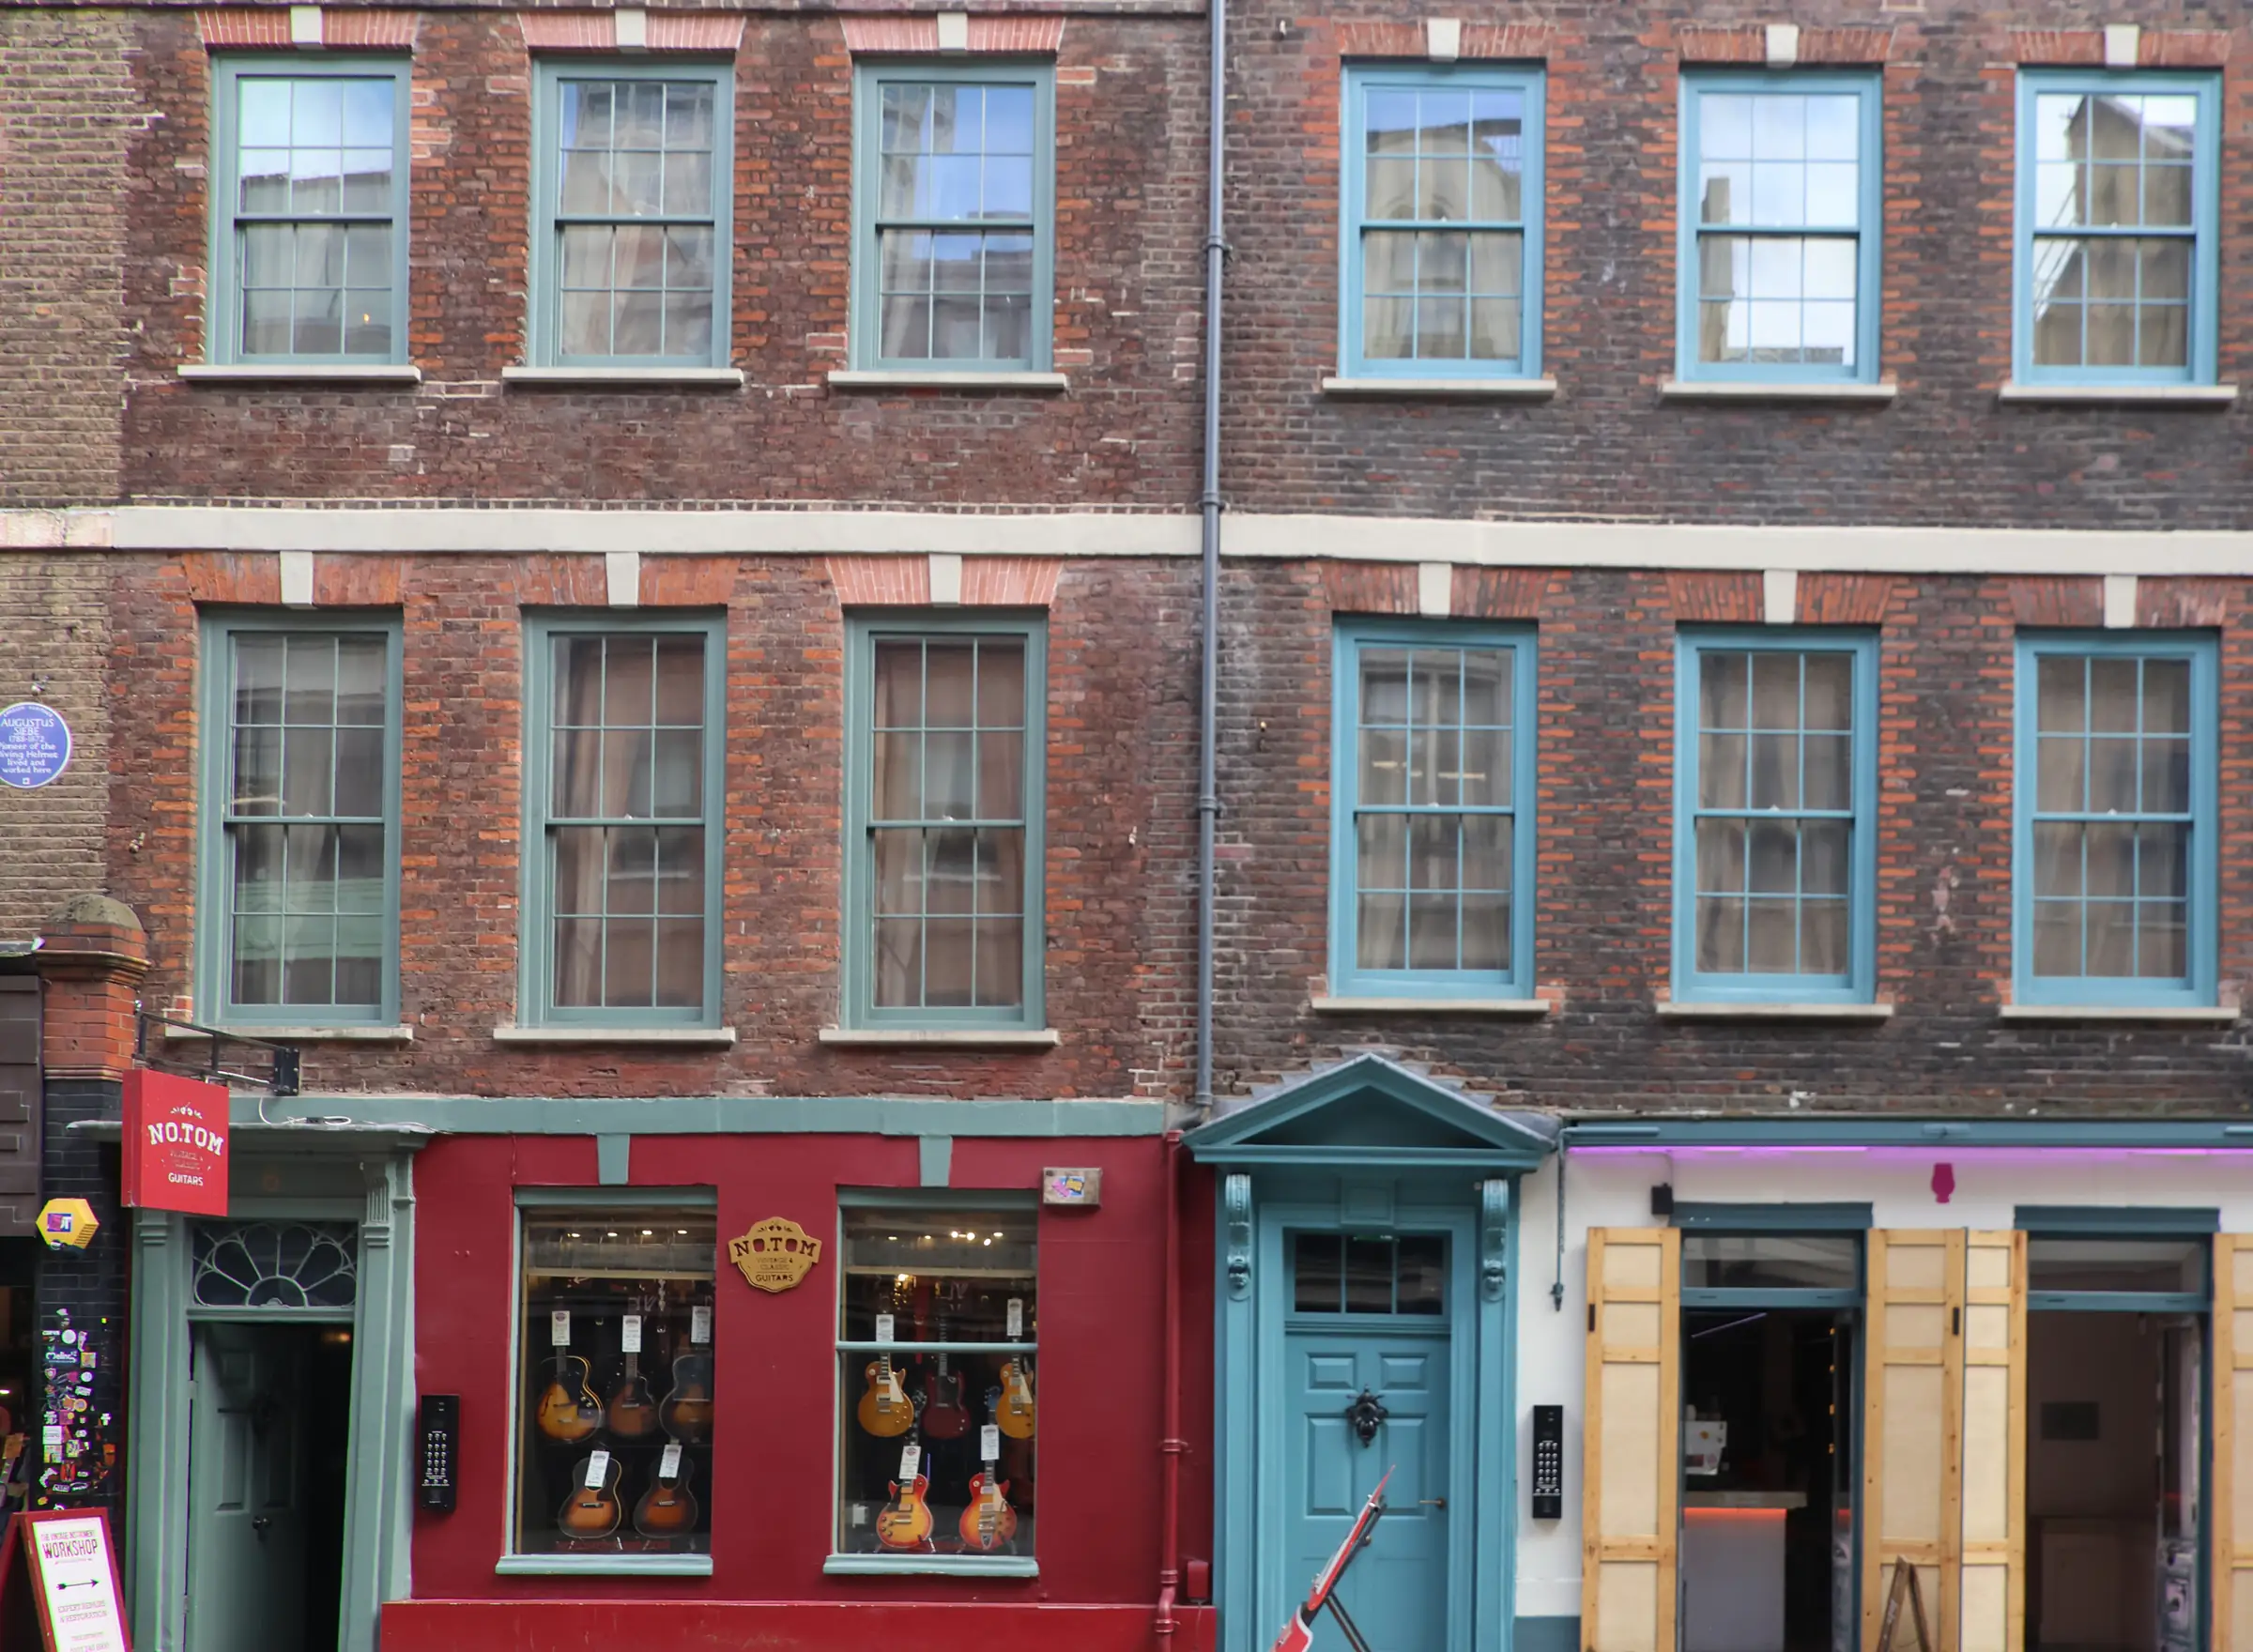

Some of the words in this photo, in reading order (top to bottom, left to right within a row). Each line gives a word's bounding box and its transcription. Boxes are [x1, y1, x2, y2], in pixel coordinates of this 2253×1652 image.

[1, 718, 54, 727] AUGUSTUS
[13, 727, 40, 735] SIEBE
[25, 750, 59, 758] Helmet
[168, 1171, 204, 1186] GUITARS
[42, 1539, 98, 1559] WORKSHOP
